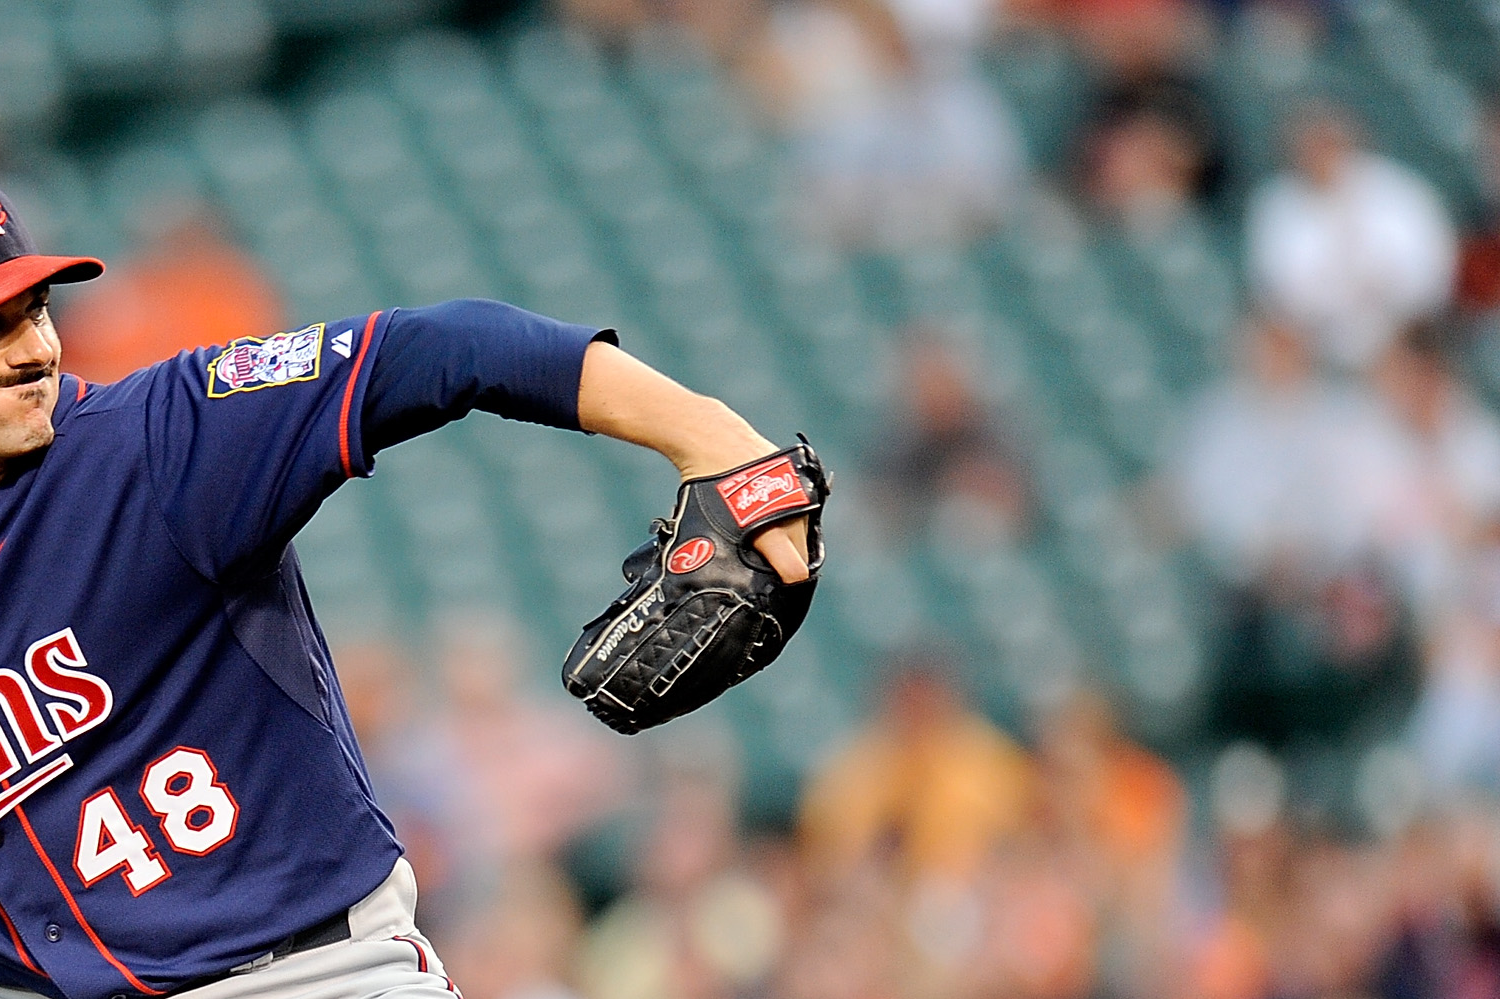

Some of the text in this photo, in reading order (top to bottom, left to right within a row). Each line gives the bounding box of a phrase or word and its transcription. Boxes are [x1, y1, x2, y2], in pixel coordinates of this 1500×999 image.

[231, 347, 254, 387] Twins
[736, 472, 794, 511] Rawlings
[674, 540, 711, 570] R
[72, 746, 239, 897] 48
